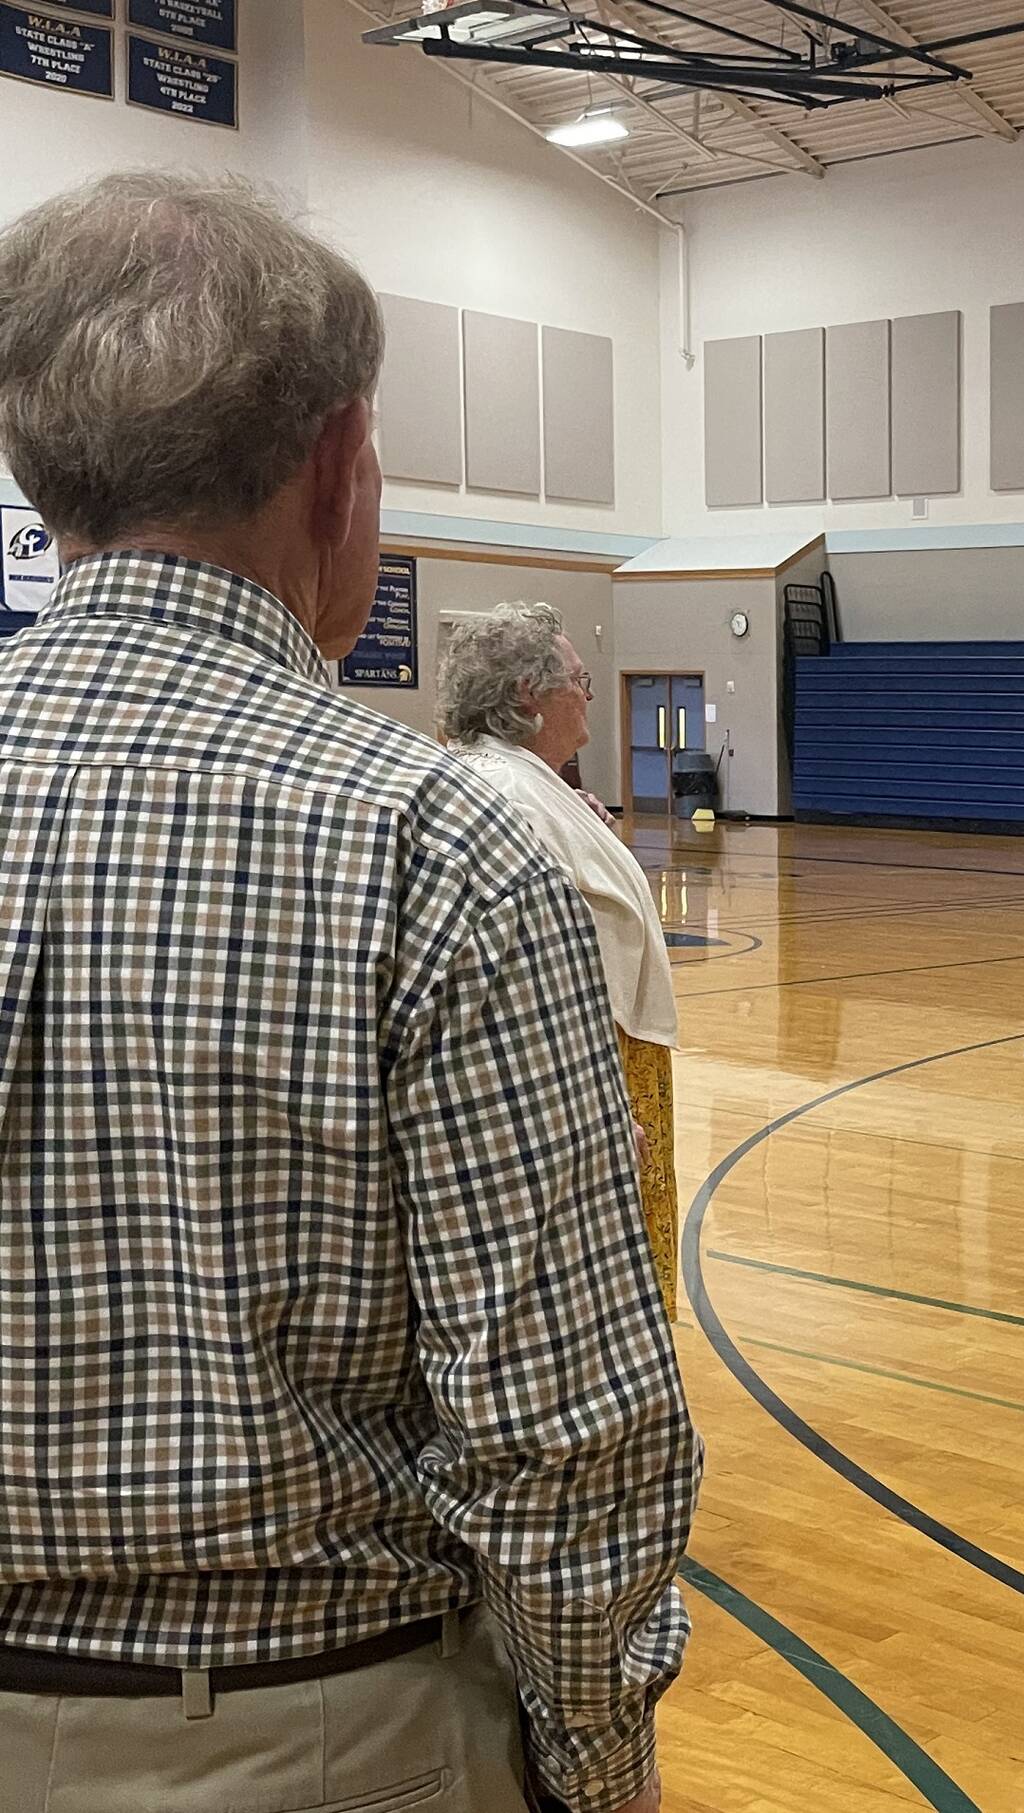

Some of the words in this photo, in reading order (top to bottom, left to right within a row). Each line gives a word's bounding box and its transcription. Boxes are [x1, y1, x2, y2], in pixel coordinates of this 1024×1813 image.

[16, 26, 46, 42] STATE
[48, 36, 78, 50] CLASS
[27, 42, 85, 62] WRESTLING
[30, 54, 50, 67] 7TH
[52, 60, 80, 74] PLACE
[144, 57, 172, 72] STATE
[173, 66, 201, 80] CLASS
[156, 72, 208, 92] WRESTLING
[178, 90, 206, 104] PLACE
[354, 668, 397, 680] SPARTANS
